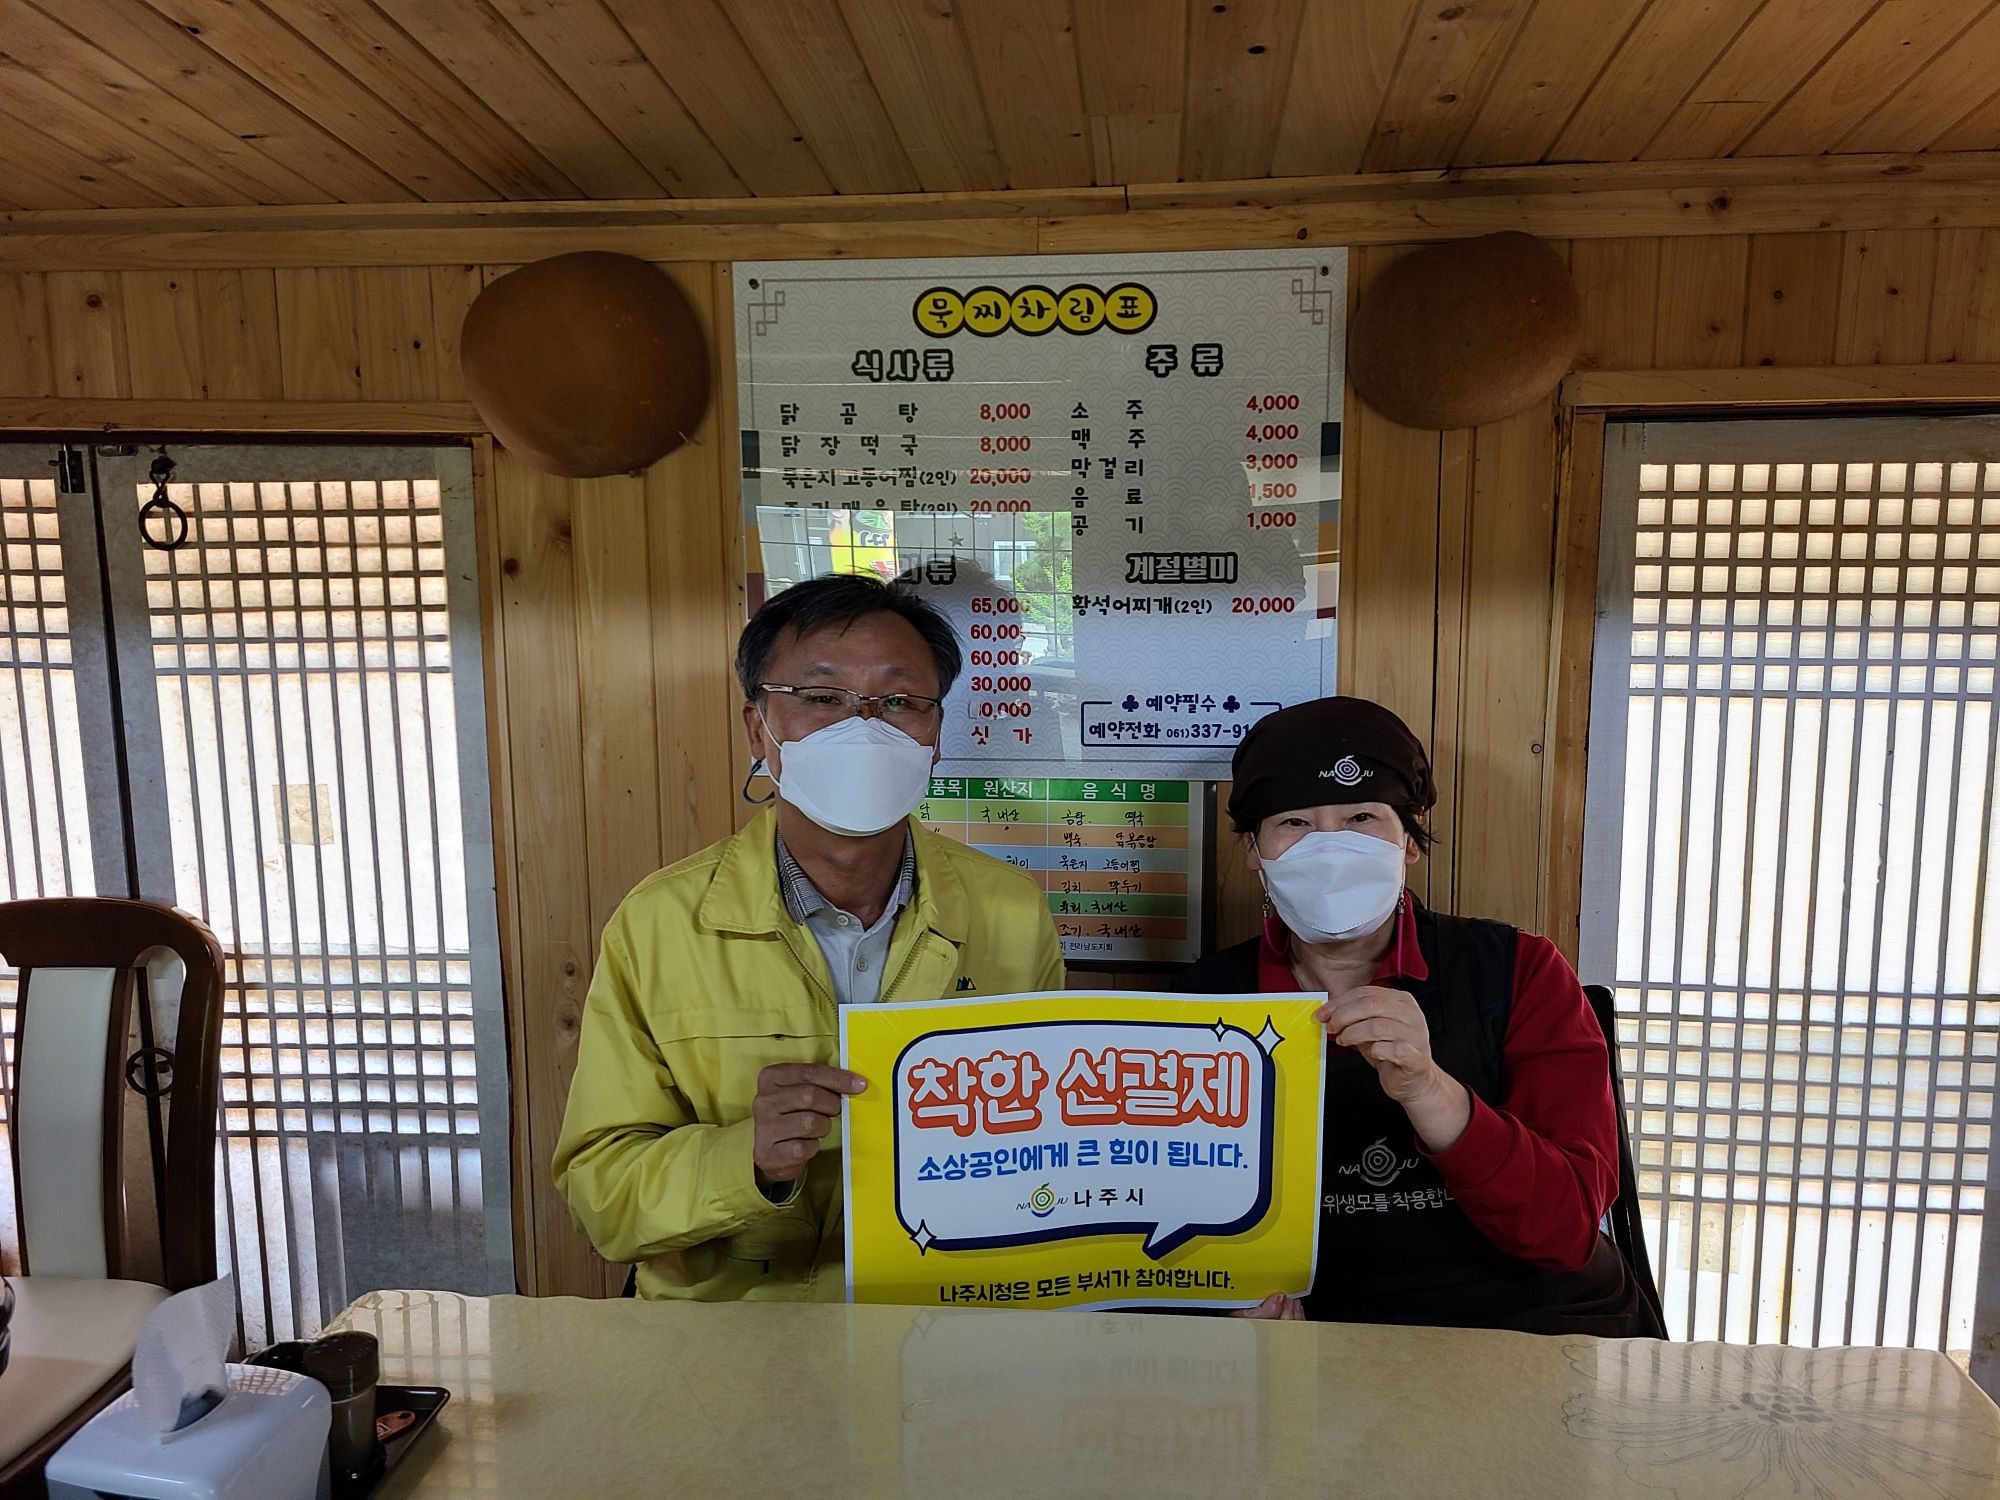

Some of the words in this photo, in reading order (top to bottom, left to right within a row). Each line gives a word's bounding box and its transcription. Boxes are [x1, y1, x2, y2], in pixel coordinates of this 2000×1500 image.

[851, 349, 954, 382] 식사류
[980, 403, 1031, 422] 8,000
[1246, 395, 1299, 413] 4,000
[1246, 425, 1299, 443] 4,000
[980, 436, 1031, 455] 8,000
[1246, 454, 1298, 472] 3,000
[969, 468, 1031, 487] 20,000
[1248, 483, 1297, 502] 1,500
[970, 500, 1031, 513] 20000
[1248, 512, 1296, 530] 1,000
[1126, 552, 1238, 584] 계절별미
[1232, 597, 1295, 615] 20,000
[971, 676, 1031, 694] 30,000
[977, 702, 1031, 720] 0,000
[1146, 694, 1216, 713] 예약필수
[1089, 721, 1161, 741] 예약전화
[926, 779, 962, 797] 품목
[983, 780, 1032, 798] 원산지
[1069, 941, 1113, 951] 전라남도지회
[908, 1050, 1049, 1137] 착한
[1056, 1047, 1250, 1129] 선결제
[917, 1142, 1069, 1181] 소상공인에게
[1077, 1140, 1099, 1166] 큰
[1109, 1139, 1158, 1166] 힘이
[1167, 1141, 1248, 1169] 됩니다.
[1323, 1193, 1390, 1214] 위생모를
[940, 1281, 1030, 1302] 나주시청은
[1036, 1276, 1071, 1298] 모든
[1077, 1269, 1130, 1291] 부서가
[1136, 1268, 1235, 1290] 참여합니다.
